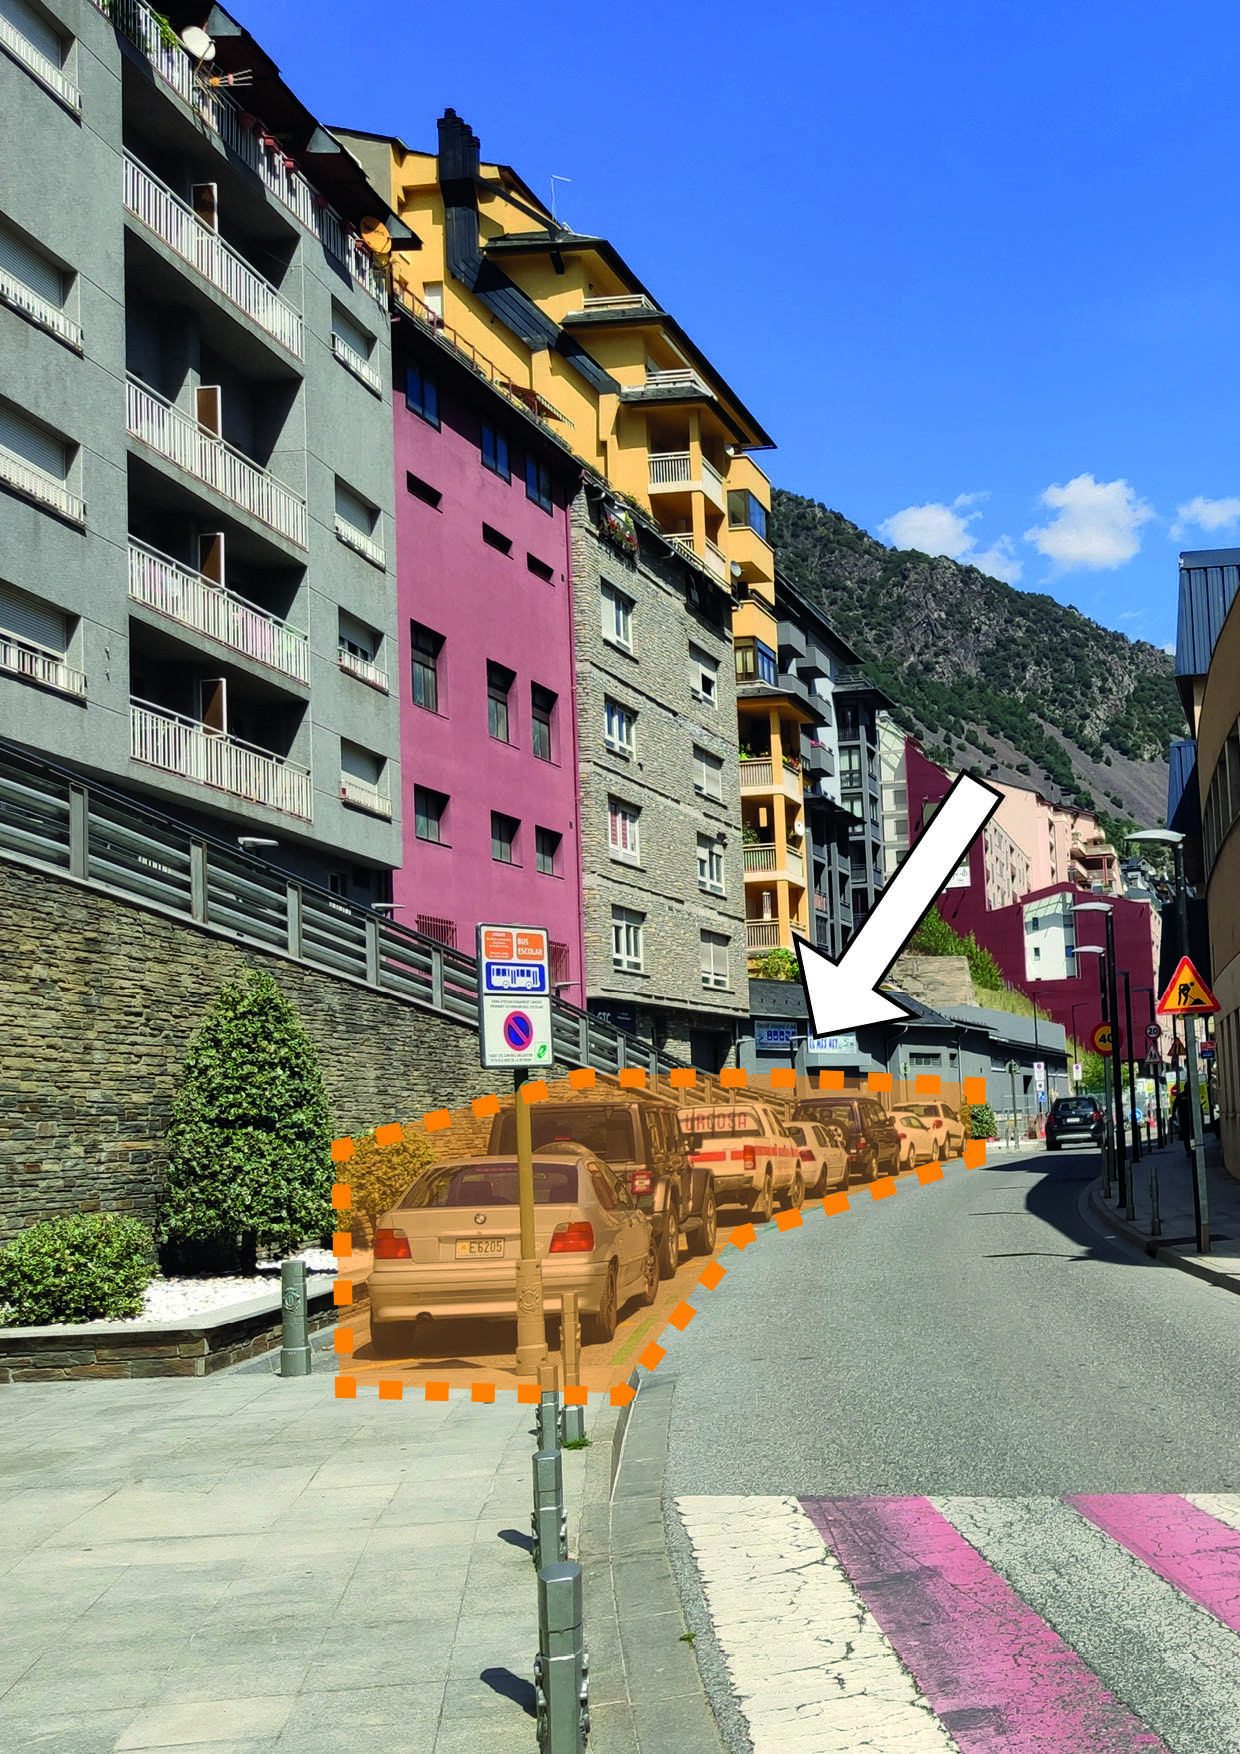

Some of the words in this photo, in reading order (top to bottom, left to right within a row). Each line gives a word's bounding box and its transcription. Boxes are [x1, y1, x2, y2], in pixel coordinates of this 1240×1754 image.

[517, 937, 529, 946] BUS
[518, 947, 543, 956] ESCOLAR
[1148, 1027, 1158, 1035] 20
[469, 1240, 502, 1253] E6205
